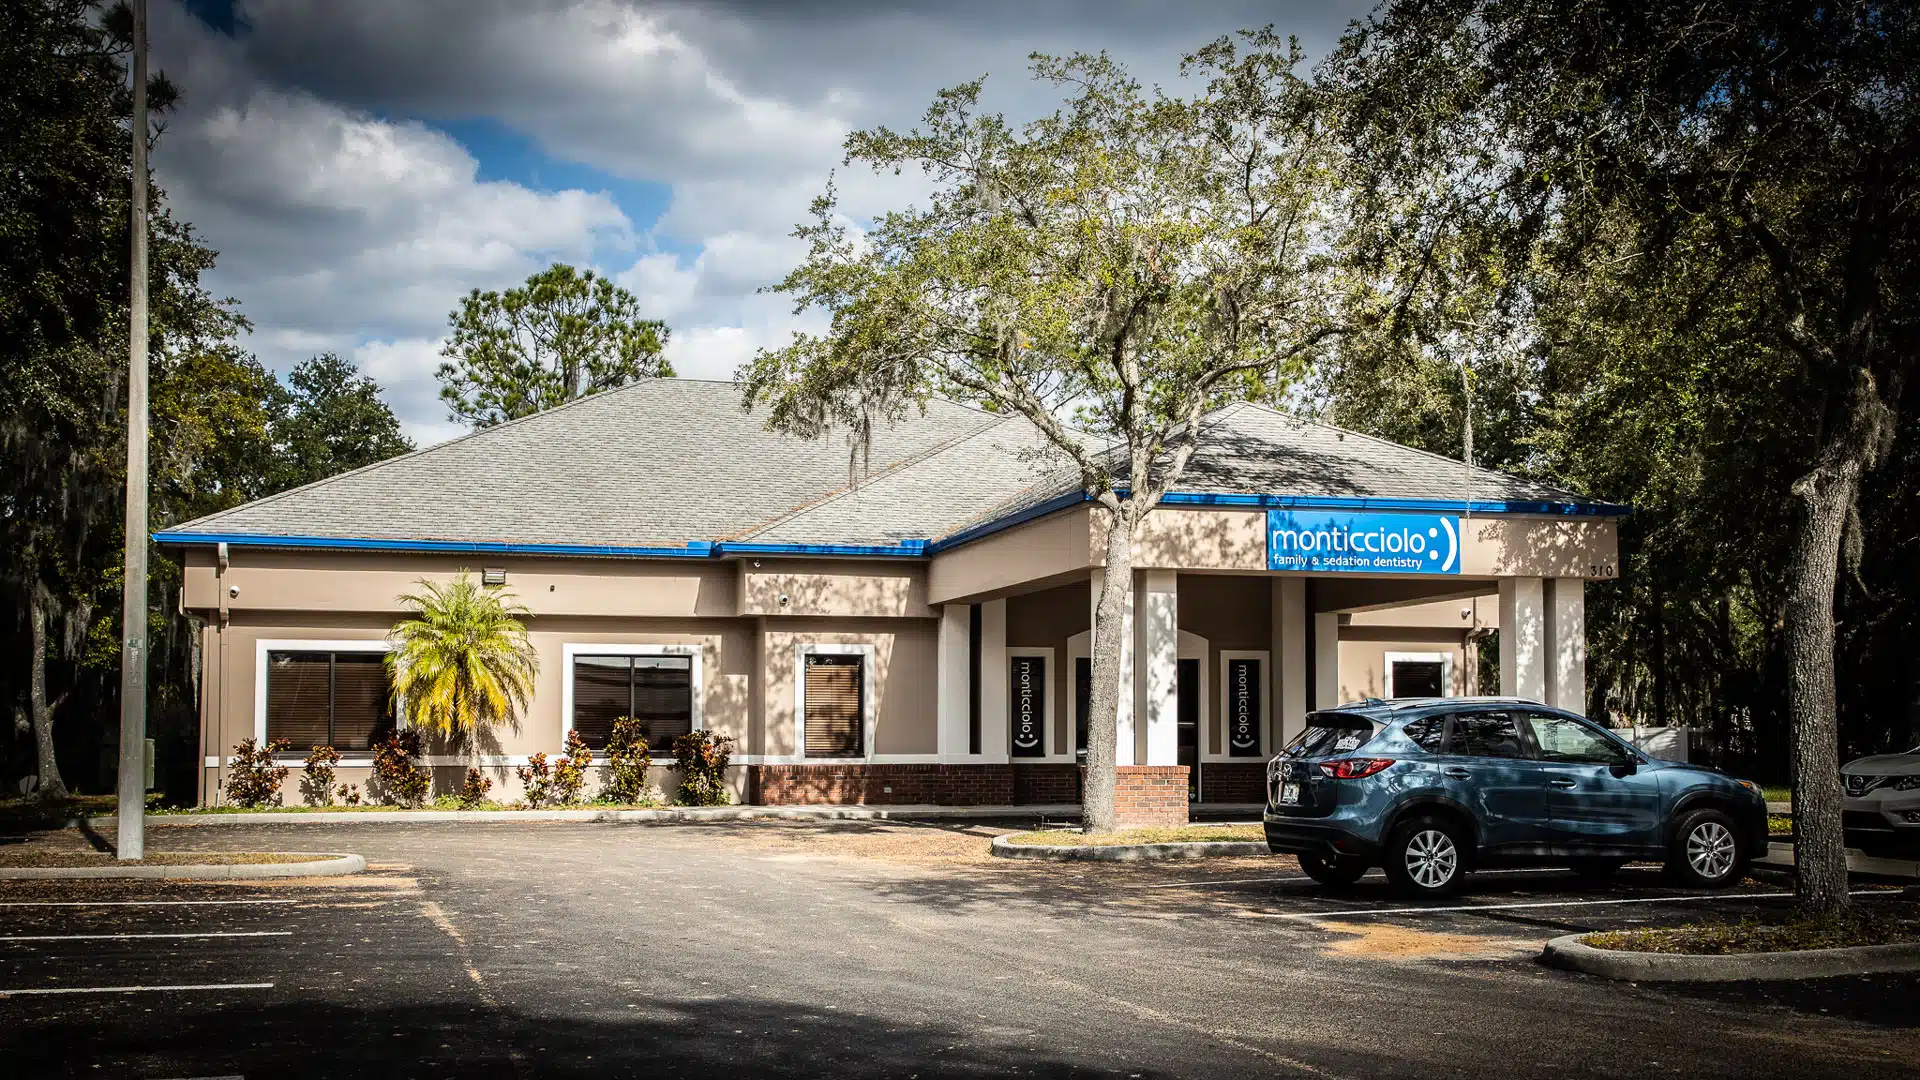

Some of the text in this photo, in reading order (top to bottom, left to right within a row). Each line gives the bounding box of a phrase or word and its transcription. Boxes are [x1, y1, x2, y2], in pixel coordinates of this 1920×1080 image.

[1272, 526, 1426, 554] monticciolo
[1273, 553, 1423, 570] family & sedation dentistry
[1590, 565, 1613, 577] 310
[1021, 662, 1032, 733] monticciolo
[1238, 664, 1250, 733] monticciolo
